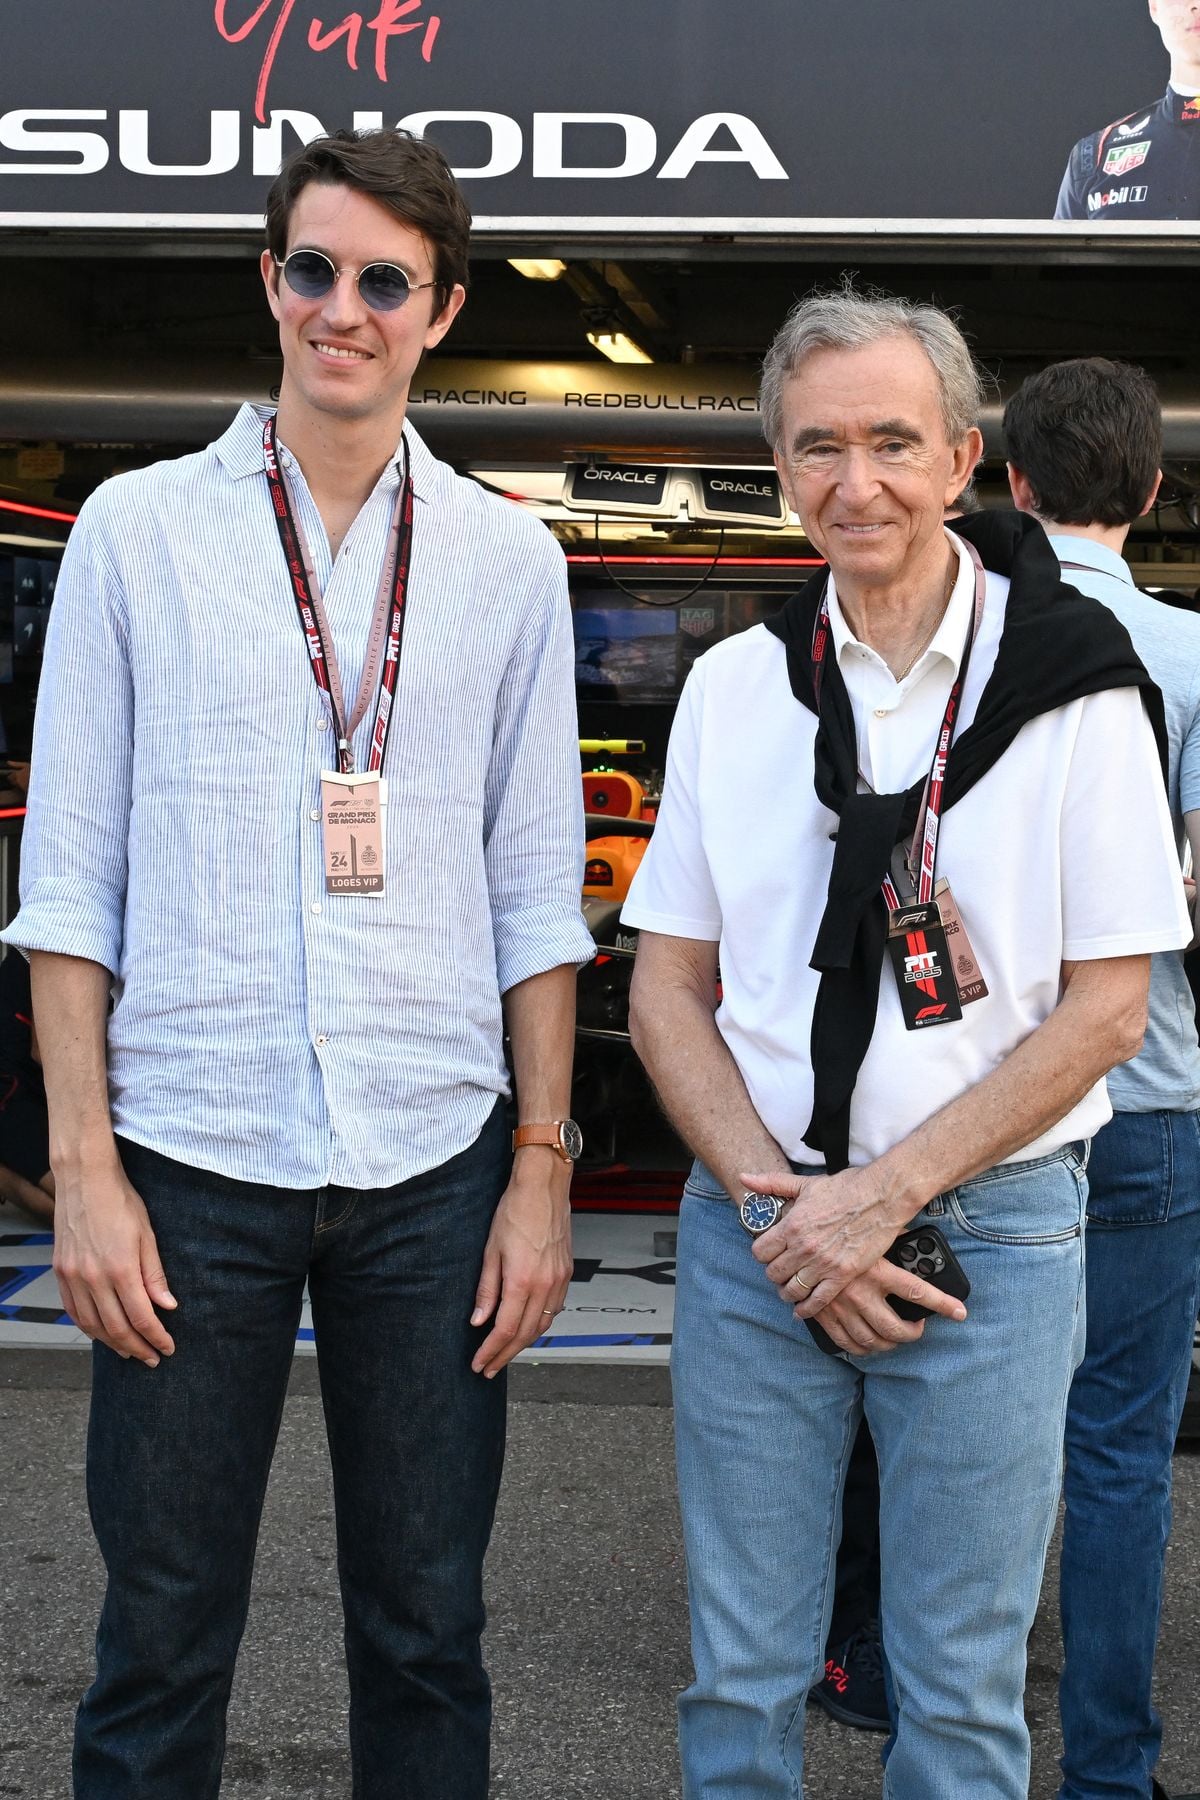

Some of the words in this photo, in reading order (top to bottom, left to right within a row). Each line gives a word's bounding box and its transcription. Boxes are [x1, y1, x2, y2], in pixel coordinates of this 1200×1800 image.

[214, 0, 440, 123] Yuki
[1111, 144, 1147, 161] TAG
[1087, 187, 1129, 211] Mobil
[407, 389, 527, 405] LRACING
[564, 392, 761, 411] REDBULLRACI
[263, 448, 277, 471] PIT
[583, 468, 658, 484] ORACLE
[709, 479, 773, 496] ORACLE
[271, 484, 287, 517] 2025
[301, 607, 315, 629] GRID
[391, 612, 401, 633] GRID
[356, 647, 379, 716] AUTOMOBILE
[373, 617, 384, 642] CLUB
[379, 600, 386, 612] DE
[383, 552, 396, 593] MONACO
[306, 633, 323, 660] PIT
[386, 635, 400, 662] PIT
[813, 630, 827, 662] 2025
[931, 754, 947, 782] PIT
[939, 729, 950, 752] GRID
[331, 855, 348, 867] 24
[331, 878, 361, 887] LOGES
[363, 877, 379, 886] VIP
[944, 920, 959, 930] RIX
[945, 926, 960, 937] ACO
[904, 950, 938, 972] PIT
[904, 965, 942, 983] 2025
[966, 984, 982, 996] VIP
[562, 1305, 657, 1314] .COM
